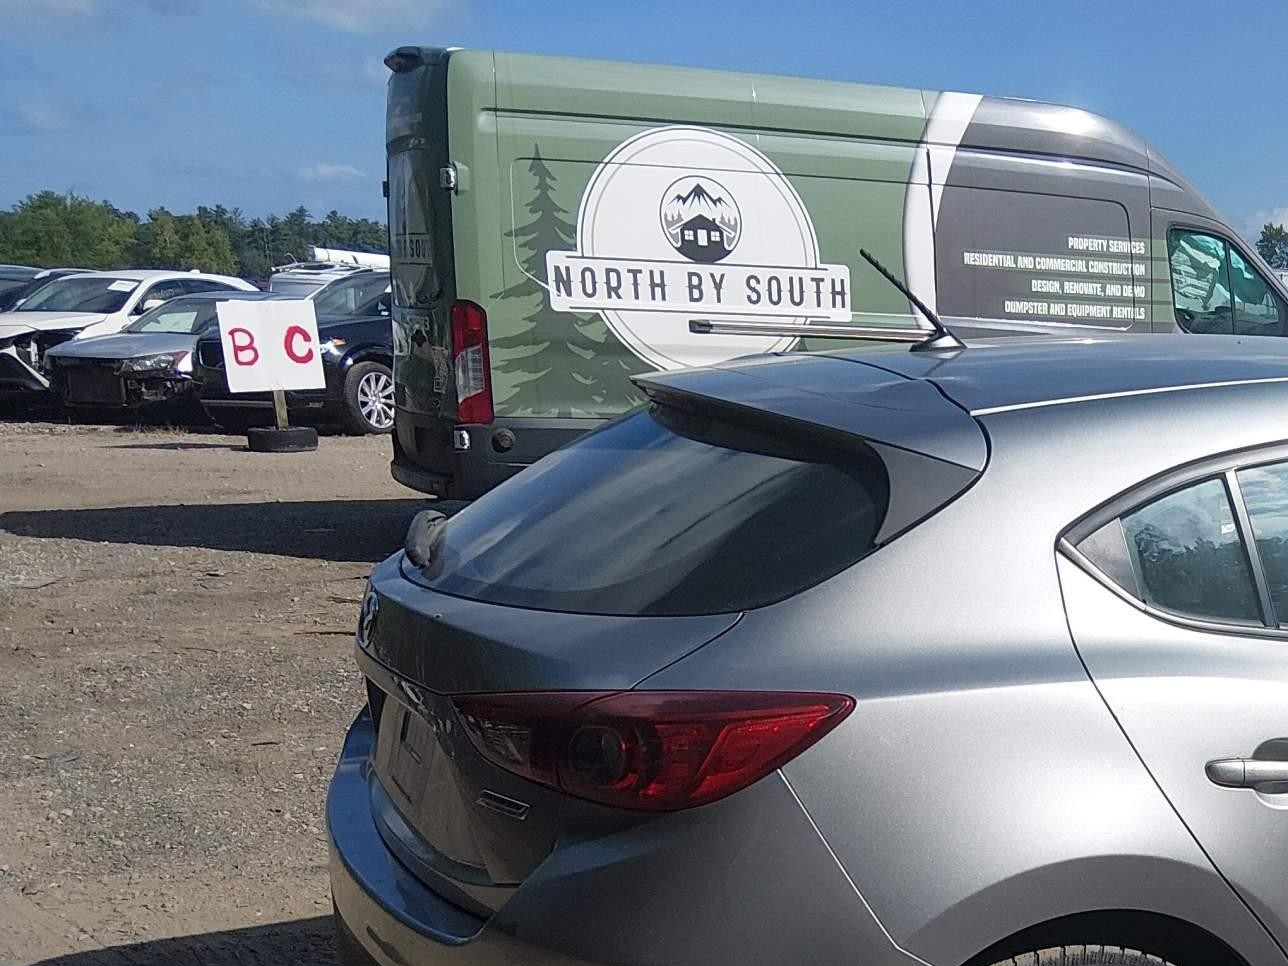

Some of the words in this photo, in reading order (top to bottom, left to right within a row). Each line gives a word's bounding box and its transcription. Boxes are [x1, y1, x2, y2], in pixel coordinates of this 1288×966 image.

[1068, 236, 1107, 252] PROPERTY
[1108, 240, 1146, 254] SERVICES
[963, 251, 1016, 268] RESIDENTIAL
[1017, 256, 1034, 269] AND
[1035, 256, 1088, 272] COMMERCIAL
[1088, 260, 1146, 276] CONSTRUCTION
[553, 264, 668, 302] NORTH
[687, 271, 726, 304] BY
[746, 275, 847, 309] SOUTH
[1031, 279, 1062, 294] DESIGN,
[1063, 281, 1104, 297] RENOVATE,
[1105, 284, 1122, 297] AND
[1122, 285, 1146, 298] DEMO
[1004, 300, 1048, 315] DUMPSTER
[1049, 302, 1066, 316] AND
[1067, 302, 1111, 318] EQUIPMENT
[1112, 306, 1146, 320] RENTALS
[228, 327, 259, 366] B
[284, 325, 314, 364] C
